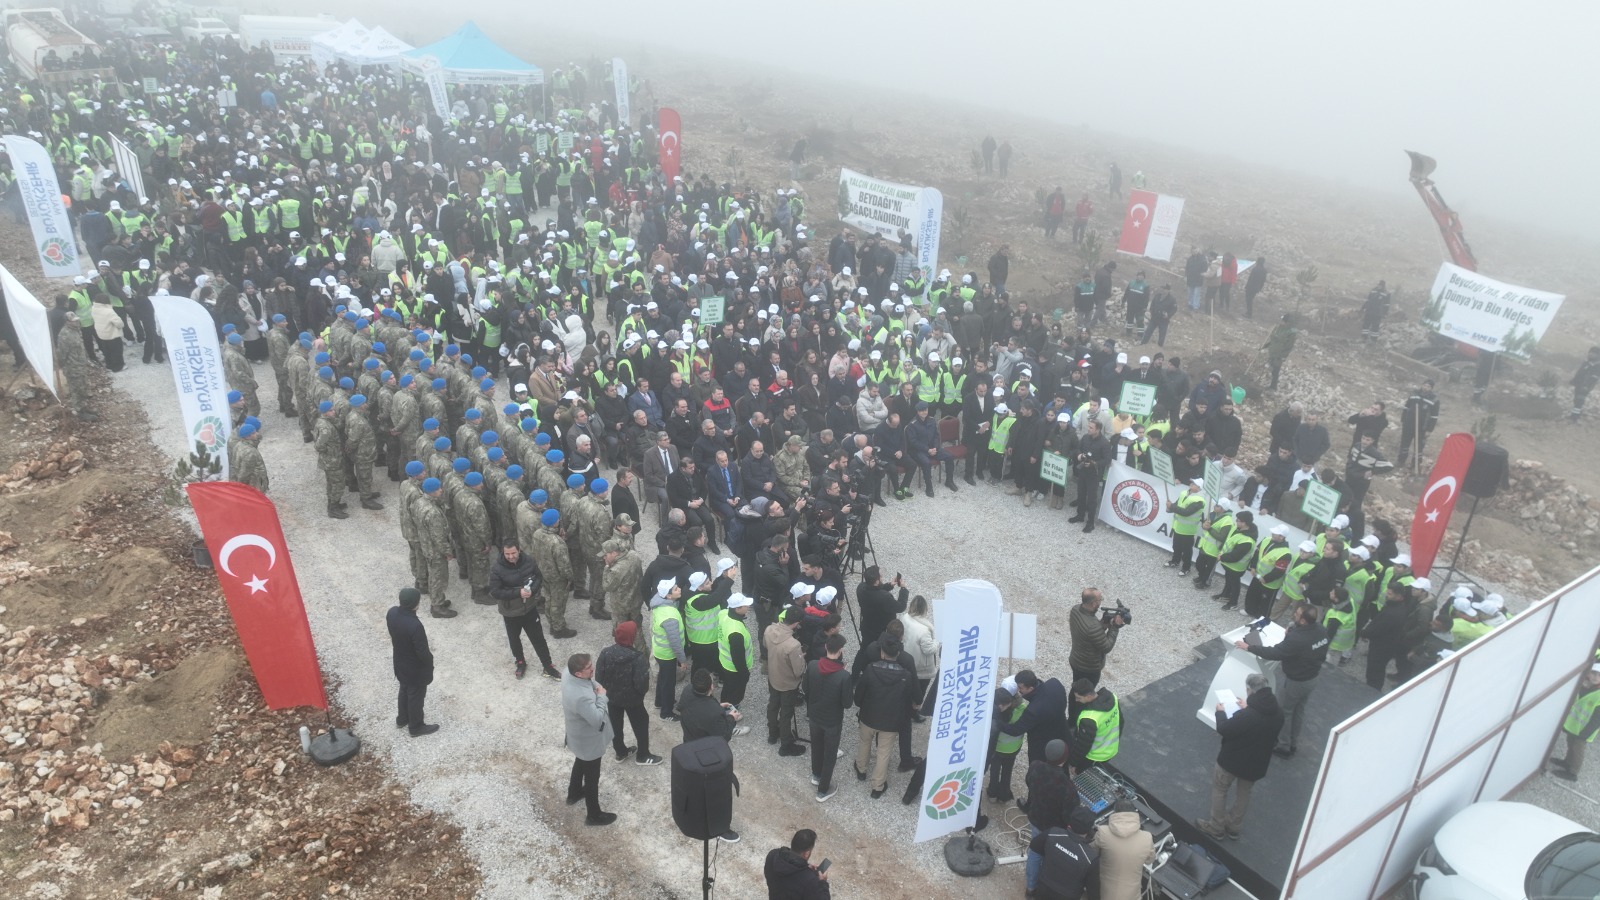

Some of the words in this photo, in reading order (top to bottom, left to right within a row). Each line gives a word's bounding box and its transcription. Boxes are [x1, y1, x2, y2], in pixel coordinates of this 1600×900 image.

[858, 191, 903, 213] BEYDAĞI'NI
[1444, 288, 1482, 311] Dünya'ya
[1484, 301, 1502, 316] Bin
[1502, 306, 1534, 327] Nefes
[1518, 294, 1550, 312] Fidan
[1055, 843, 1079, 861] HONDA
